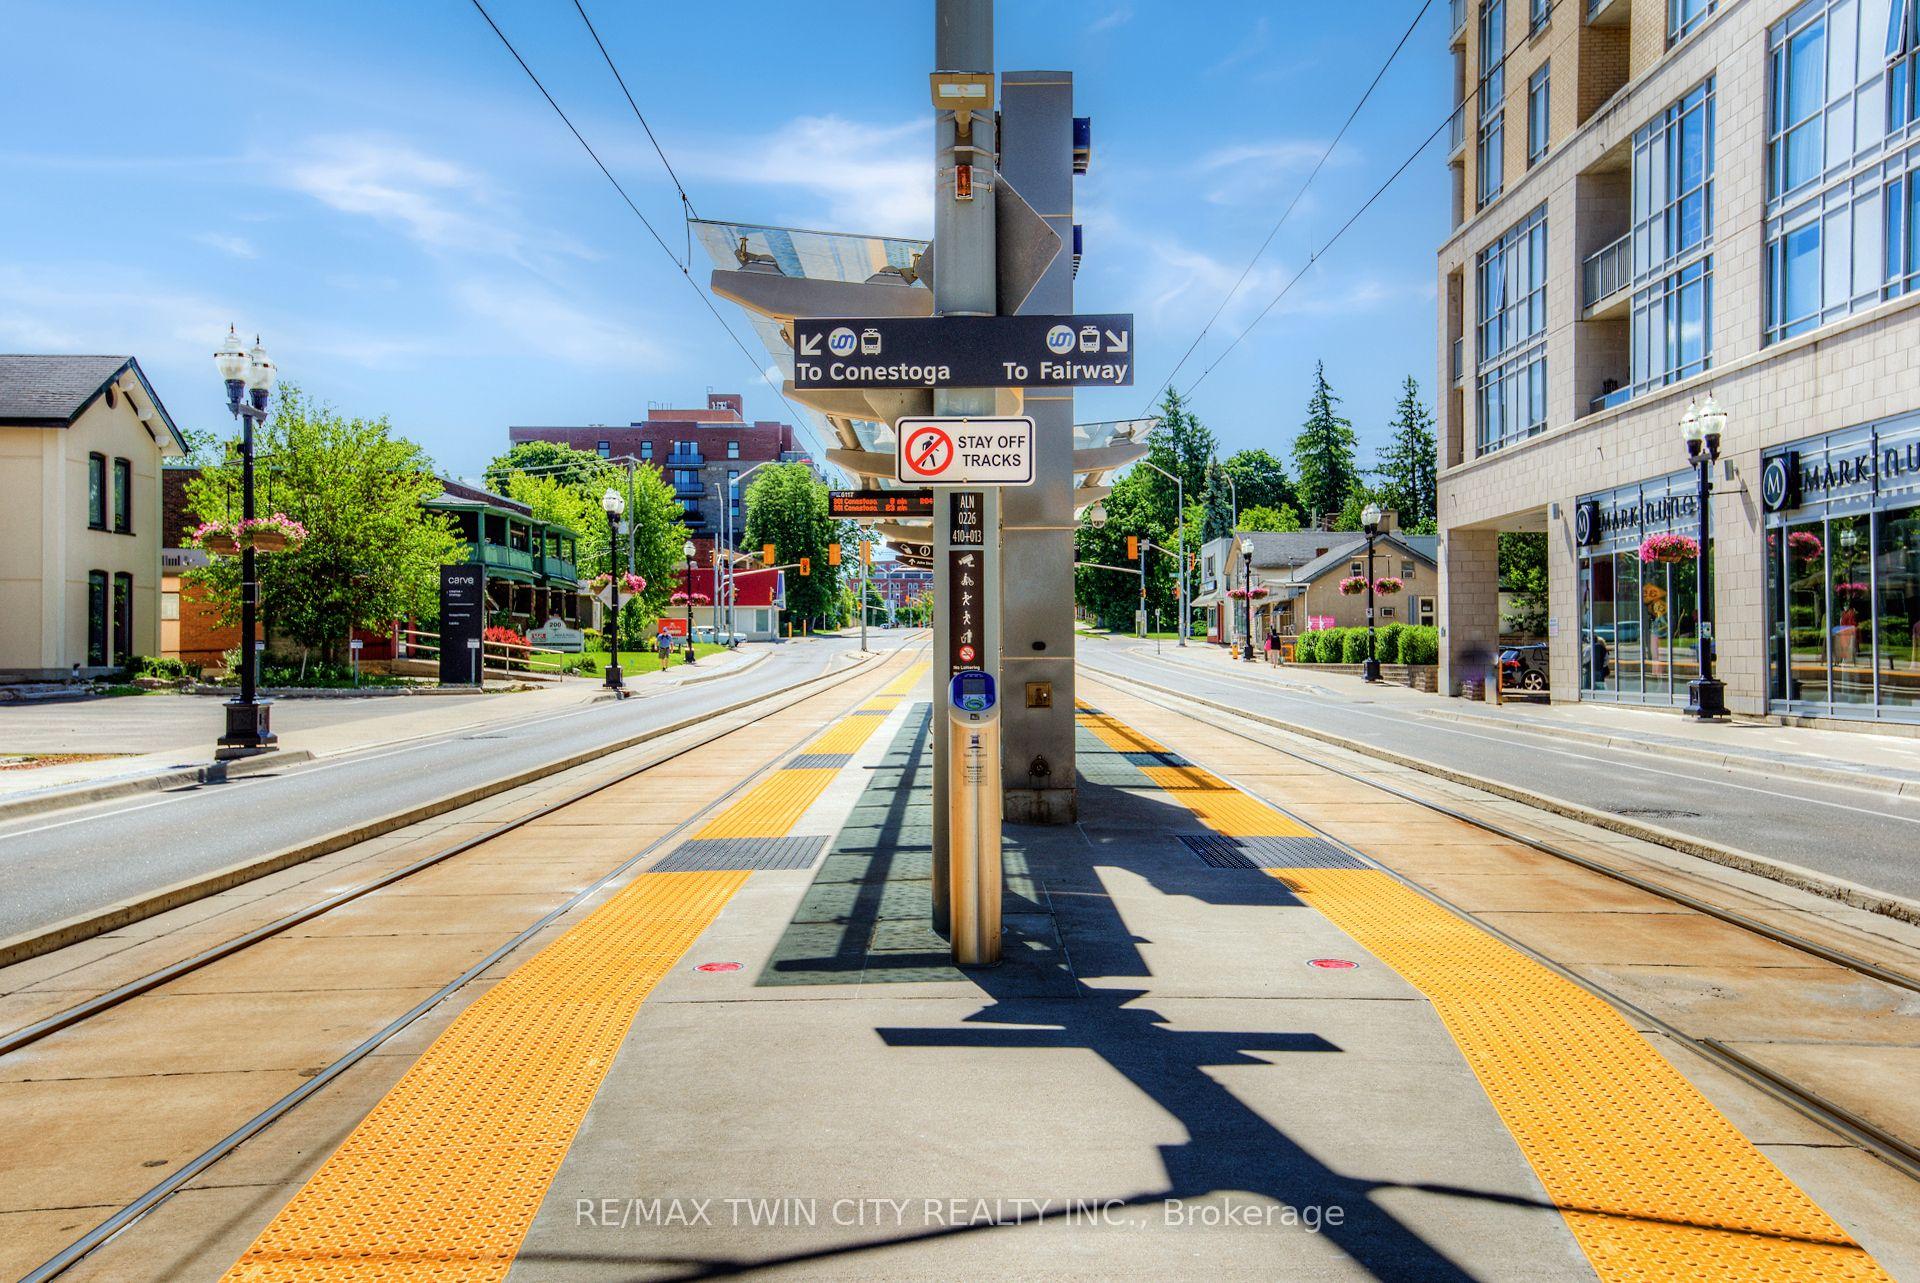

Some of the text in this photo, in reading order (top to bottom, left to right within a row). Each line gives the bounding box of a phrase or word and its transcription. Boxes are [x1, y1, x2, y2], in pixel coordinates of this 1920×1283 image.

[797, 362, 950, 385] To Conestoga
[1002, 360, 1128, 384] To Fairway
[958, 435, 1026, 449] STAY OFF
[962, 453, 1021, 467] TRACKS
[1804, 455, 1868, 493] MARK
[960, 495, 975, 508] ALN
[958, 512, 977, 525] 0226
[1601, 506, 1637, 532] MARK
[952, 530, 982, 543] 410+013
[448, 577, 474, 585] carve
